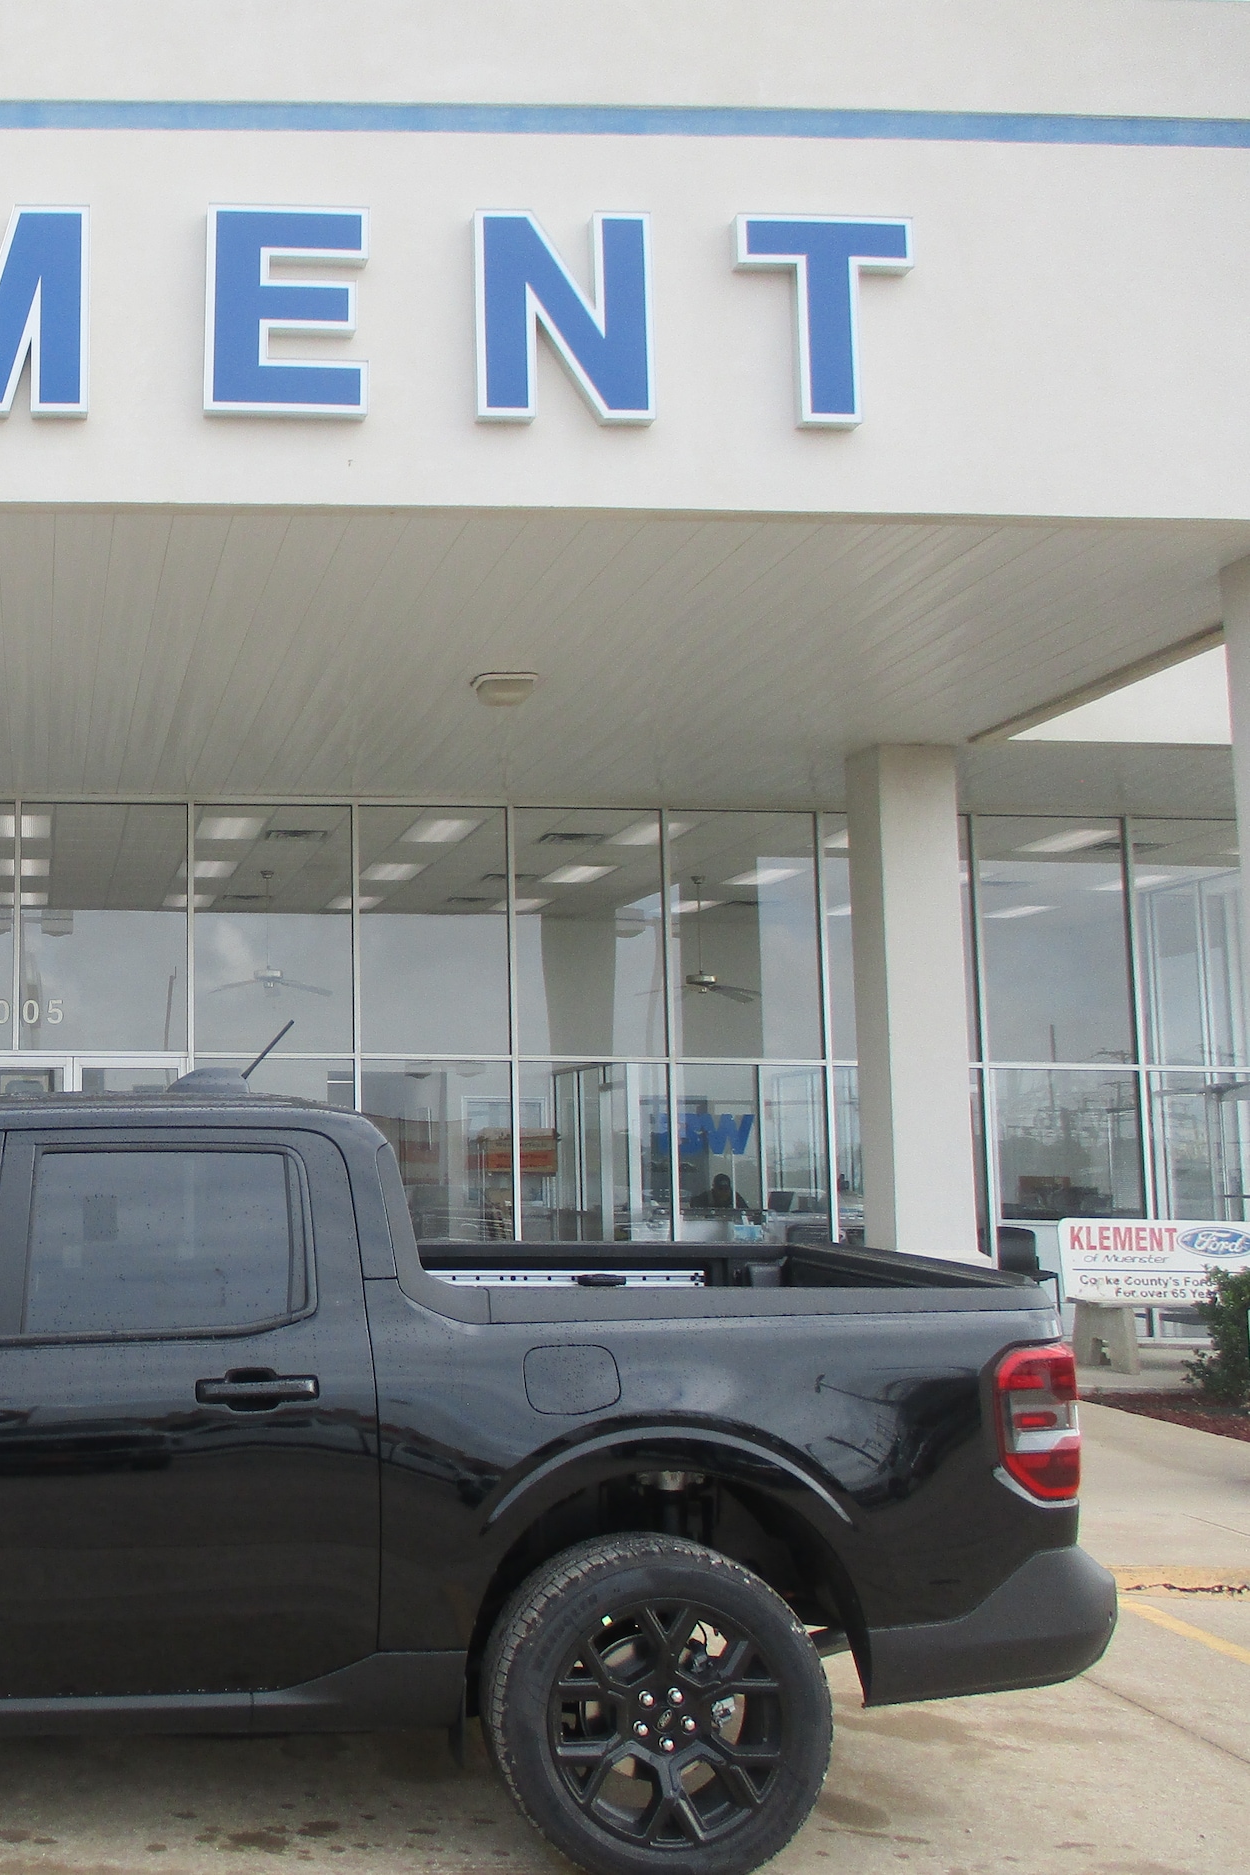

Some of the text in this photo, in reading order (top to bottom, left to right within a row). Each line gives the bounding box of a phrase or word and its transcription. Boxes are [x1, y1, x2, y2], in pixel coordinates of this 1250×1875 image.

[1070, 1226, 1177, 1252] KLEMENT
[1194, 1231, 1249, 1253] Ford
[1083, 1253, 1171, 1265] of Muenster
[1079, 1275, 1120, 1286] Coke
[1124, 1276, 1180, 1289] County's
[1140, 1290, 1168, 1298] over
[1172, 1288, 1187, 1298] 65
